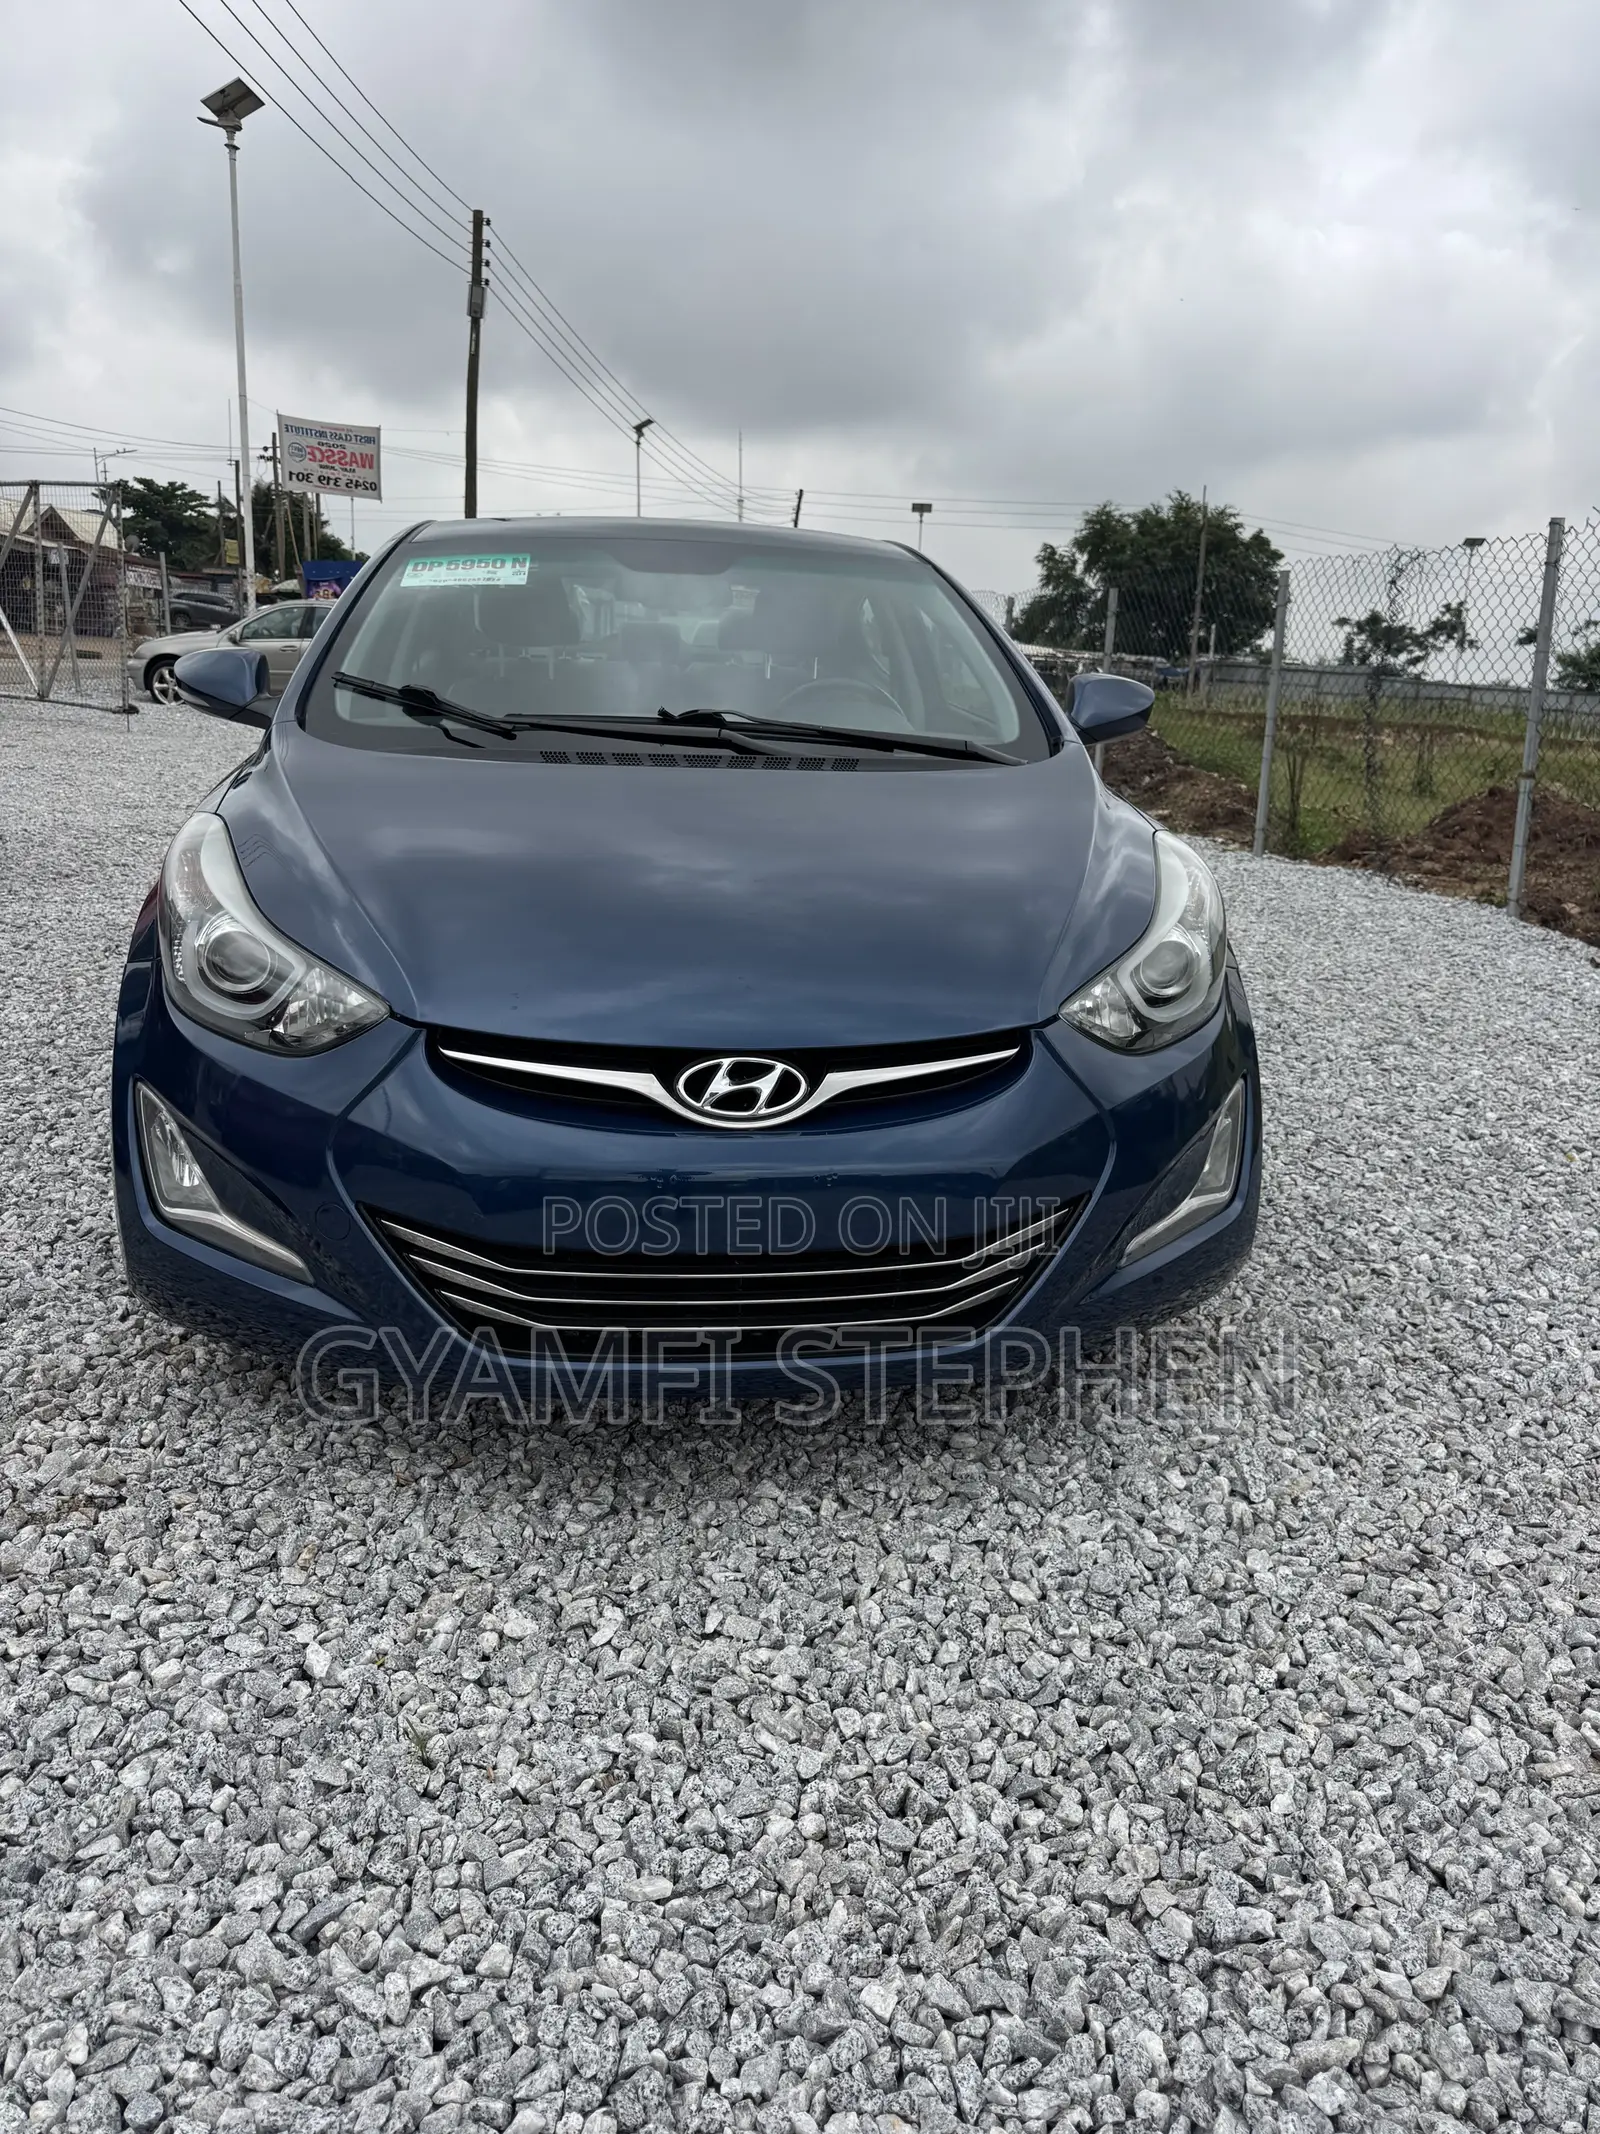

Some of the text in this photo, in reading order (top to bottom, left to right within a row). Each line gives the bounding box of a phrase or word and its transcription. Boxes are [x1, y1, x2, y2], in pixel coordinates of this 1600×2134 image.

[411, 557, 528, 572] DP 5950 N
